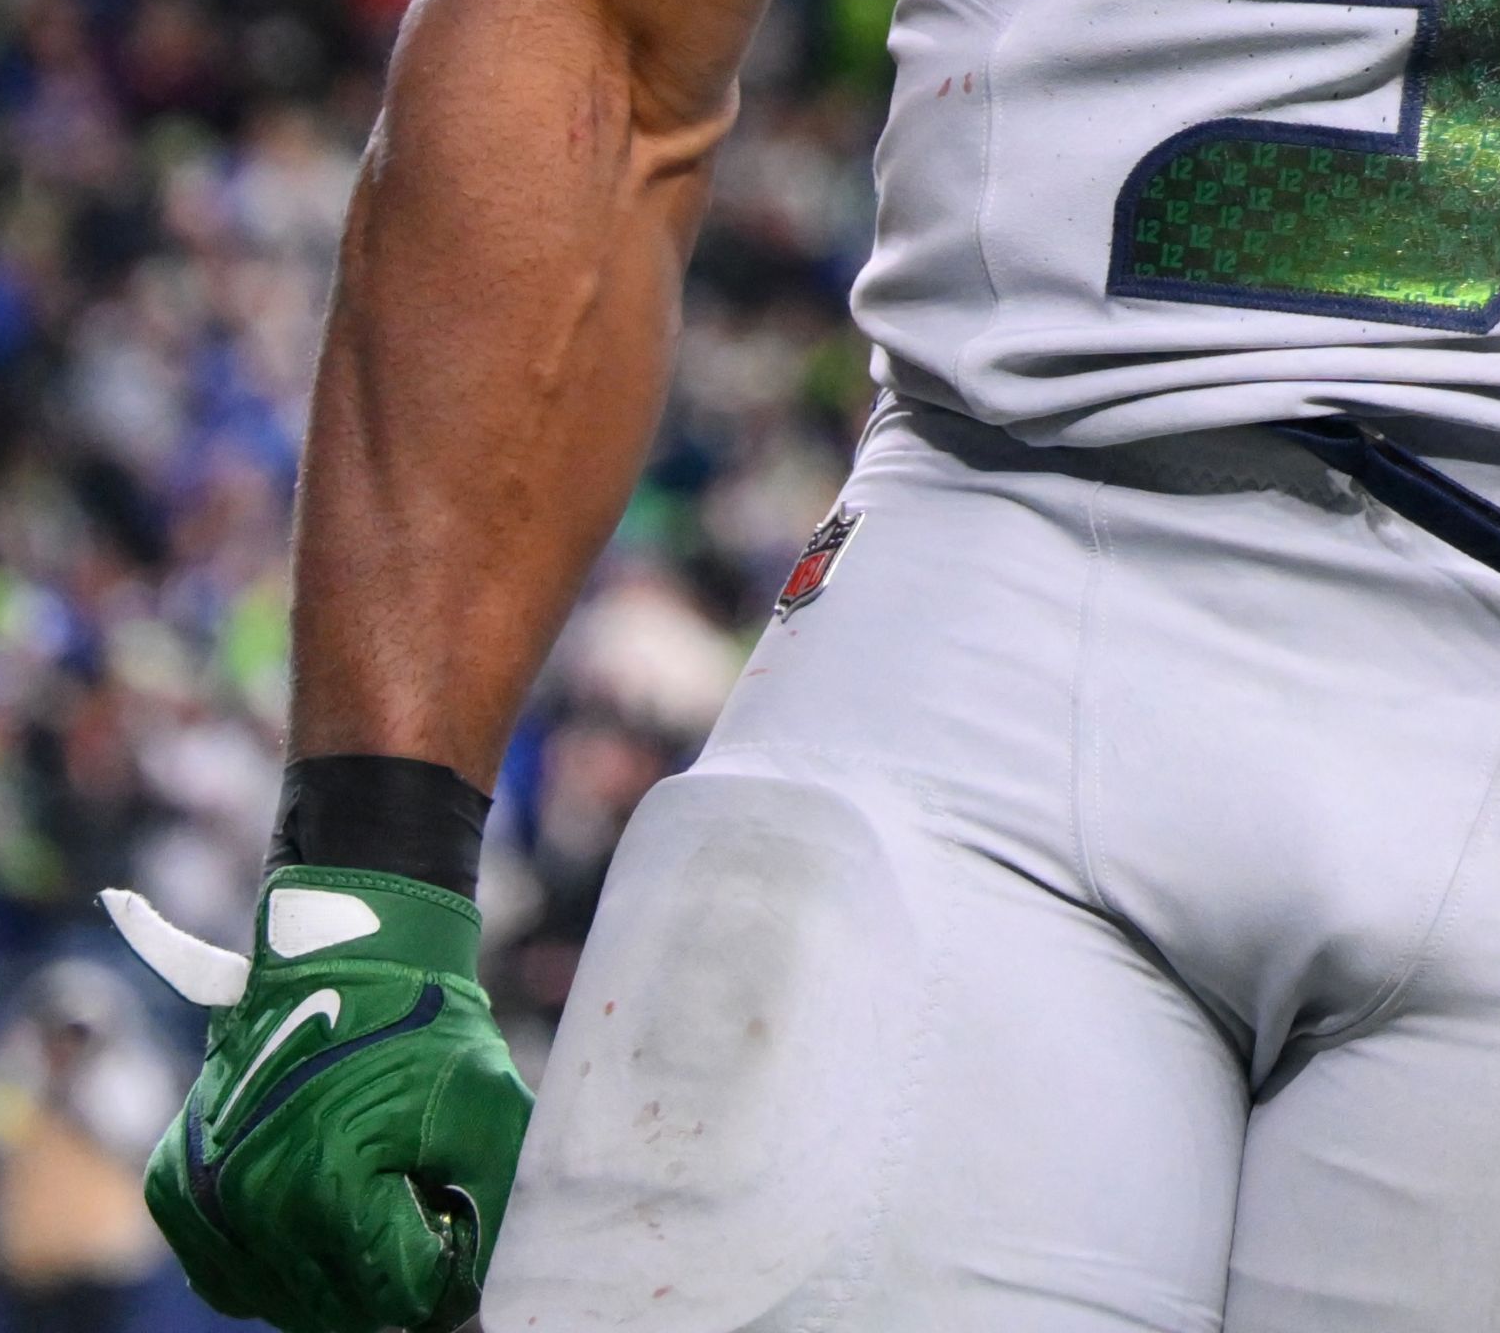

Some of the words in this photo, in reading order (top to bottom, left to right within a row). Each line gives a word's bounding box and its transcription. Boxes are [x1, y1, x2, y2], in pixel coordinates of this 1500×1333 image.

[1253, 144, 1277, 166] 12
[1308, 149, 1332, 173] 12
[1171, 158, 1193, 180] 12
[1223, 163, 1247, 186] 12
[1278, 168, 1300, 192] 12
[1142, 178, 1164, 199] 12
[1195, 182, 1219, 204] 12
[1332, 175, 1358, 197] 12
[1249, 187, 1273, 210] 12
[1305, 193, 1328, 216] 12
[1166, 201, 1189, 223] 12
[1219, 206, 1243, 229] 12
[1136, 220, 1160, 243] 12
[1190, 225, 1213, 248] 12
[1160, 244, 1184, 268] 12
[1214, 250, 1237, 272] 12
